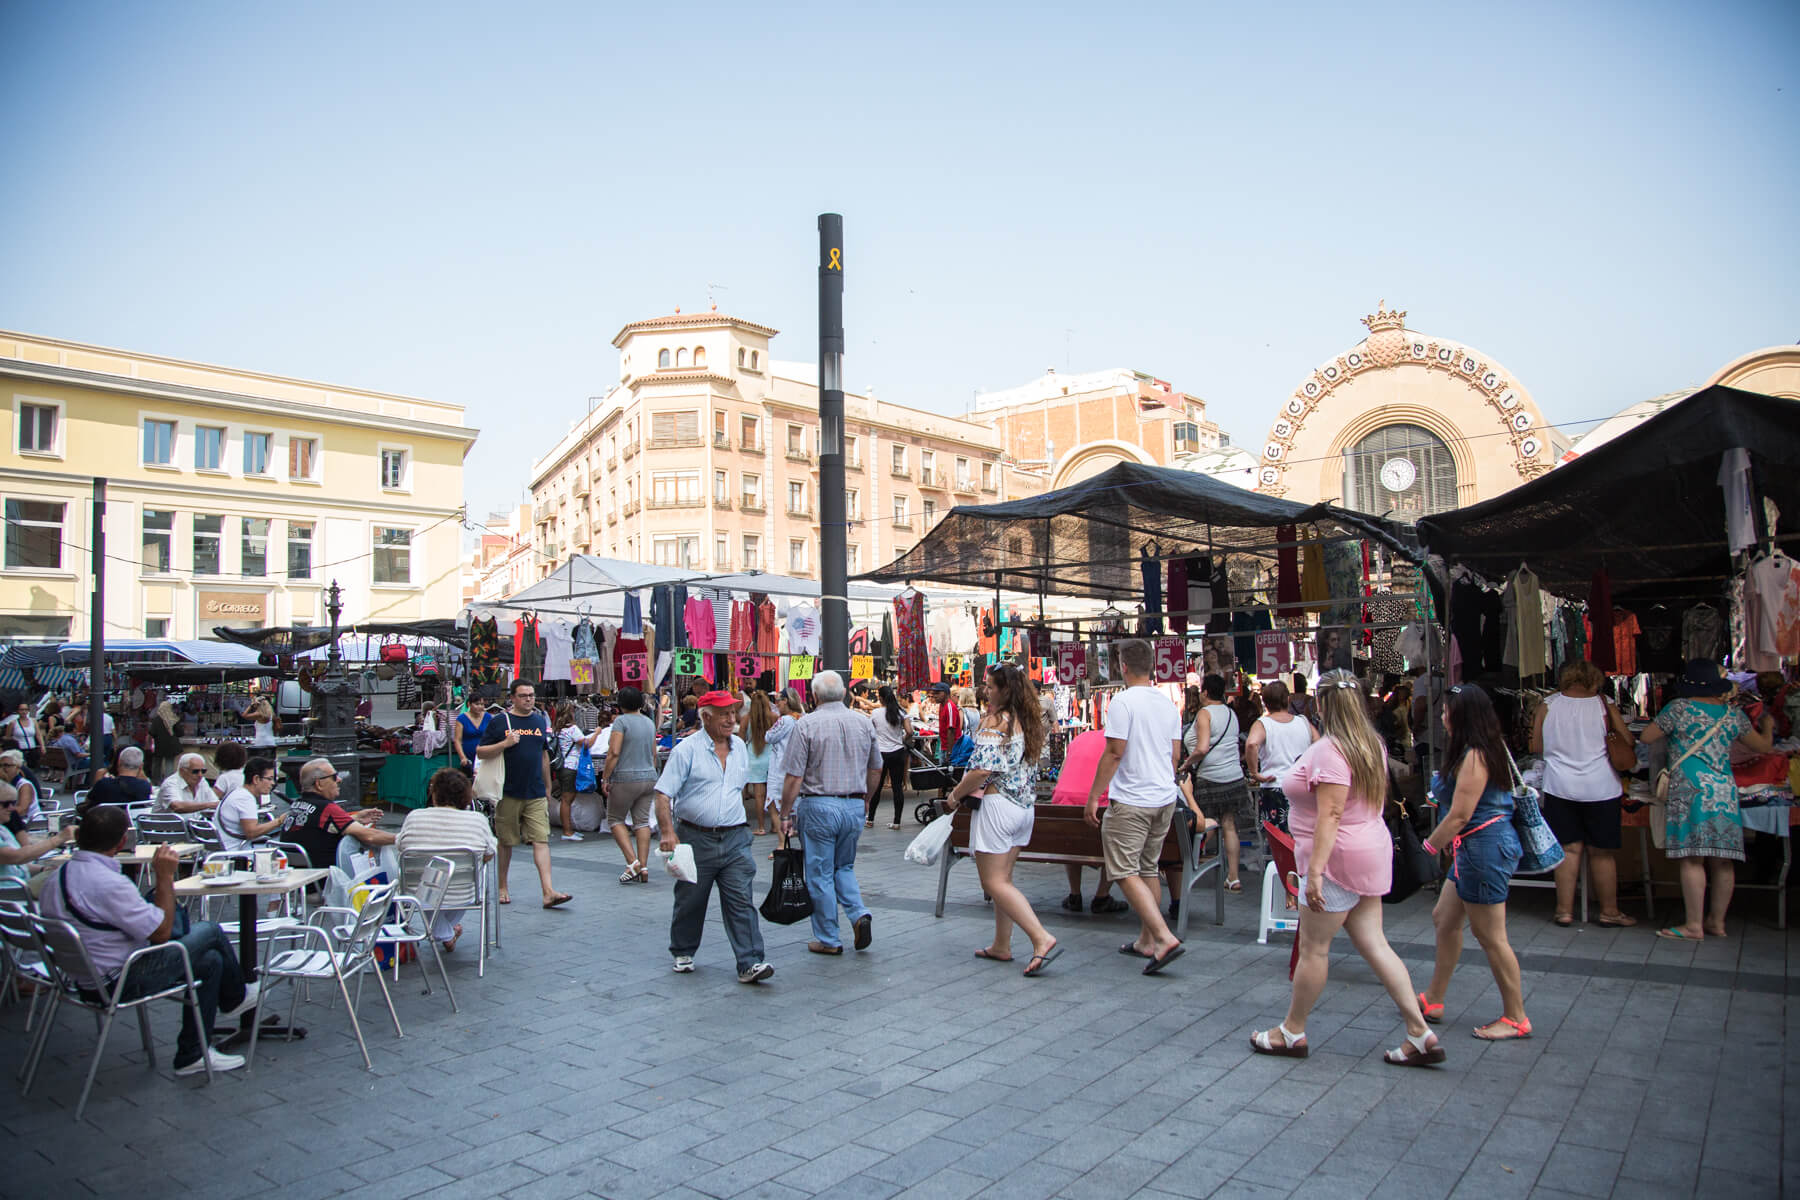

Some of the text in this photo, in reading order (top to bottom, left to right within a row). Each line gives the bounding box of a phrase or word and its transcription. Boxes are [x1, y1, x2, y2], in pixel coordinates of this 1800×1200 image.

[1262, 352, 1362, 484] MERCADO
[1059, 642, 1085, 651] OFERTA
[1156, 638, 1184, 647] OFERTA
[1257, 633, 1287, 645] OFERTA
[1060, 652, 1085, 682] 5€
[1157, 648, 1185, 679] 5€
